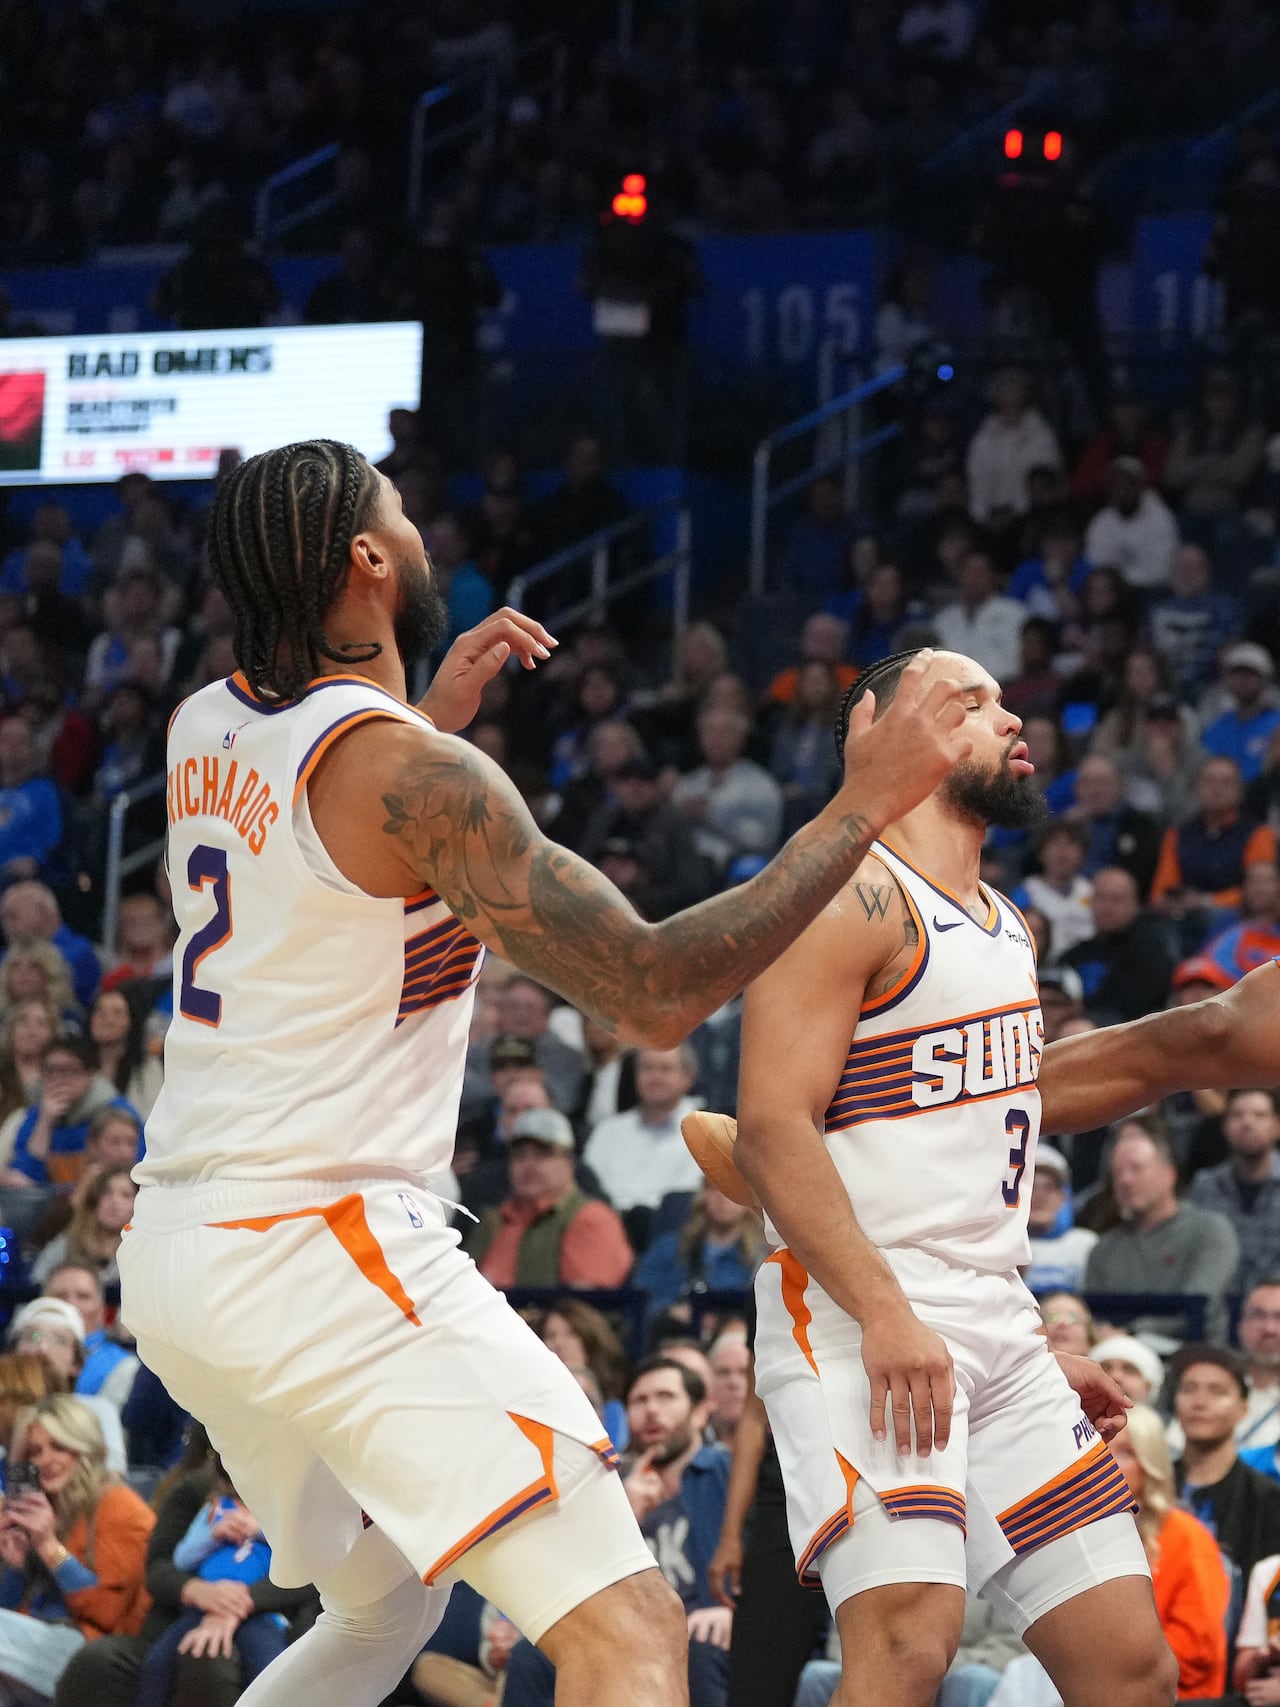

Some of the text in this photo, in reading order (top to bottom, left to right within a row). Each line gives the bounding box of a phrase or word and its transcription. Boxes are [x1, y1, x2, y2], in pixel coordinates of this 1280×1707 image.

[69, 352, 139, 379] BAD
[740, 283, 860, 360] 105
[180, 844, 234, 1029] 2
[911, 1008, 1045, 1108] SUNS
[1002, 1108, 1030, 1209] 3
